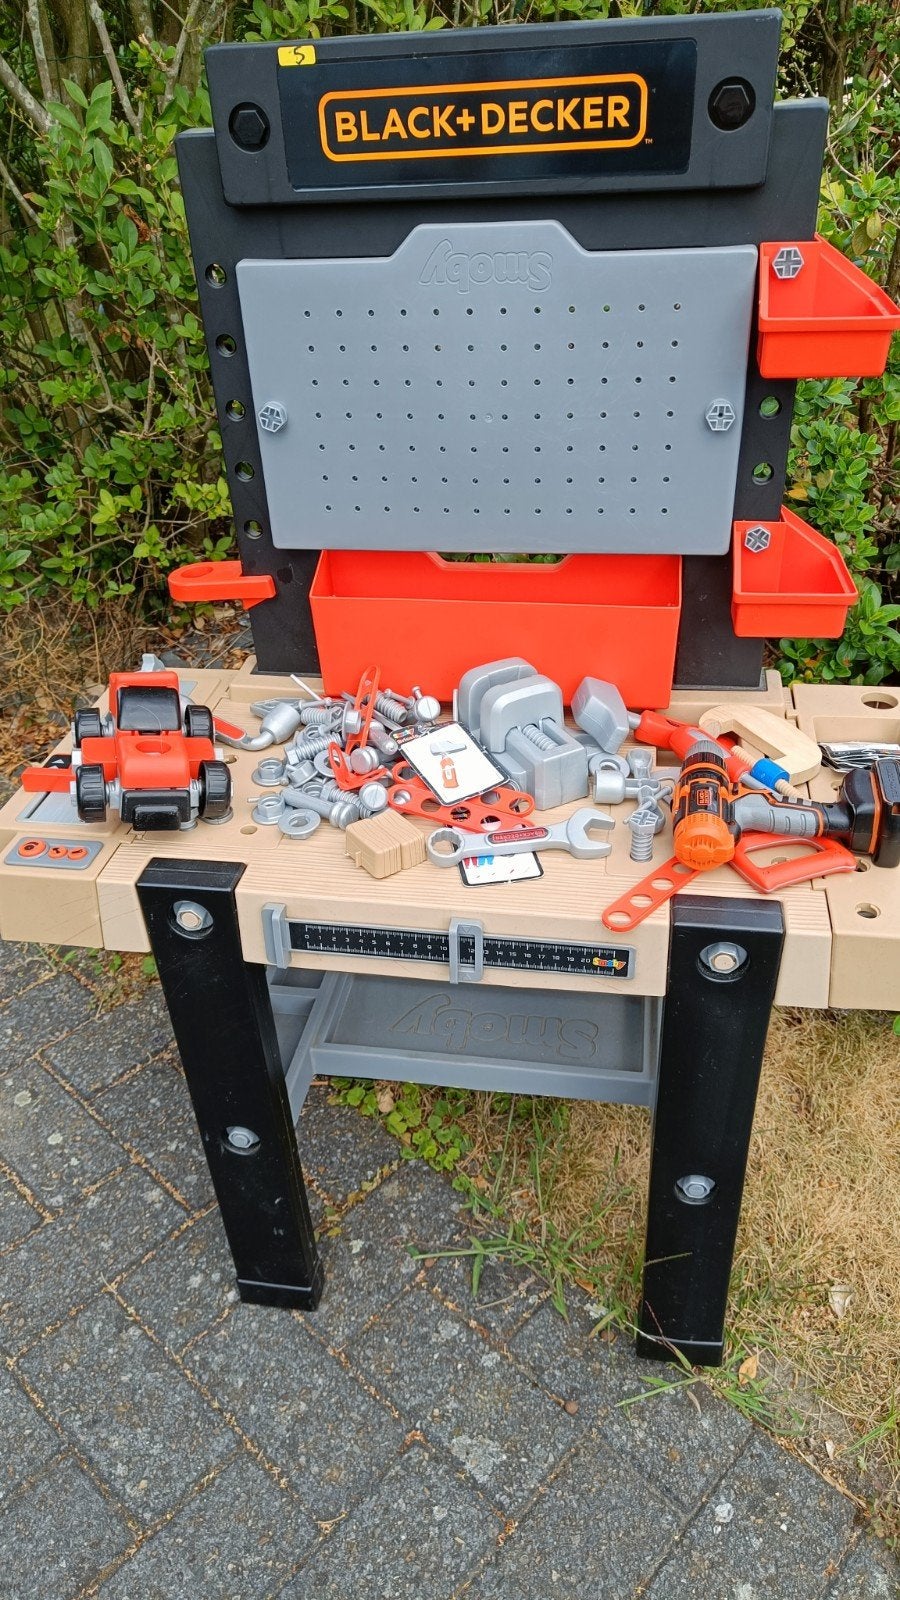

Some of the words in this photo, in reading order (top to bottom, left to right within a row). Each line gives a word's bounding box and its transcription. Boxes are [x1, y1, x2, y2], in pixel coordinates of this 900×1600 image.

[334, 94, 630, 144] BLACK+DECKER
[418, 238, 554, 294] Smoby
[389, 992, 600, 1060] Smoby
